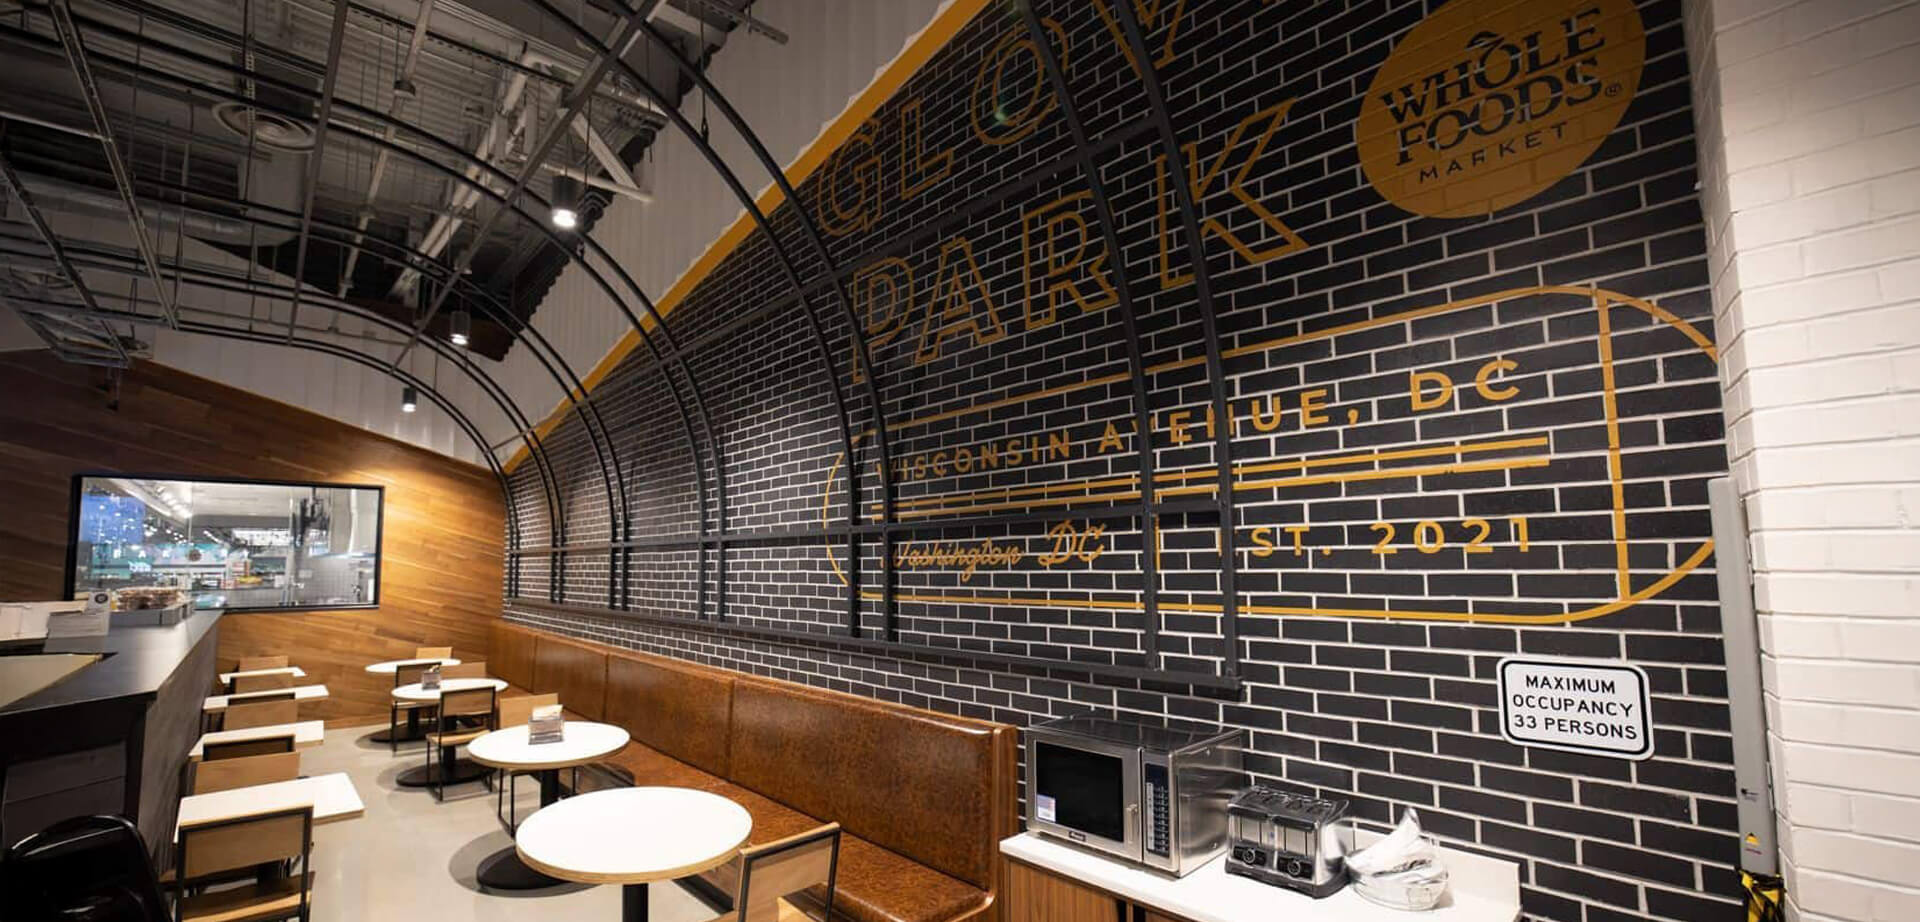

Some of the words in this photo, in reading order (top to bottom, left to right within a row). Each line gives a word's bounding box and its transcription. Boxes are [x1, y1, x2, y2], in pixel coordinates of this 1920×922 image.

[1379, 8, 1605, 124] WHOLE
[817, 0, 1288, 236] GLOV
[1397, 57, 1603, 166] FOODS
[1420, 122, 1568, 183] MARKET
[853, 98, 1310, 384] PARK
[1410, 359, 1520, 411] DC
[1038, 519, 1107, 566] DC
[1217, 526, 1332, 558] ST.
[1370, 516, 1530, 554] 2021
[1513, 694, 1632, 717] OCCUPANCY
[1525, 675, 1615, 694] MAXIMUM
[1514, 714, 1537, 729] 33
[1544, 717, 1637, 740] PERSONS
